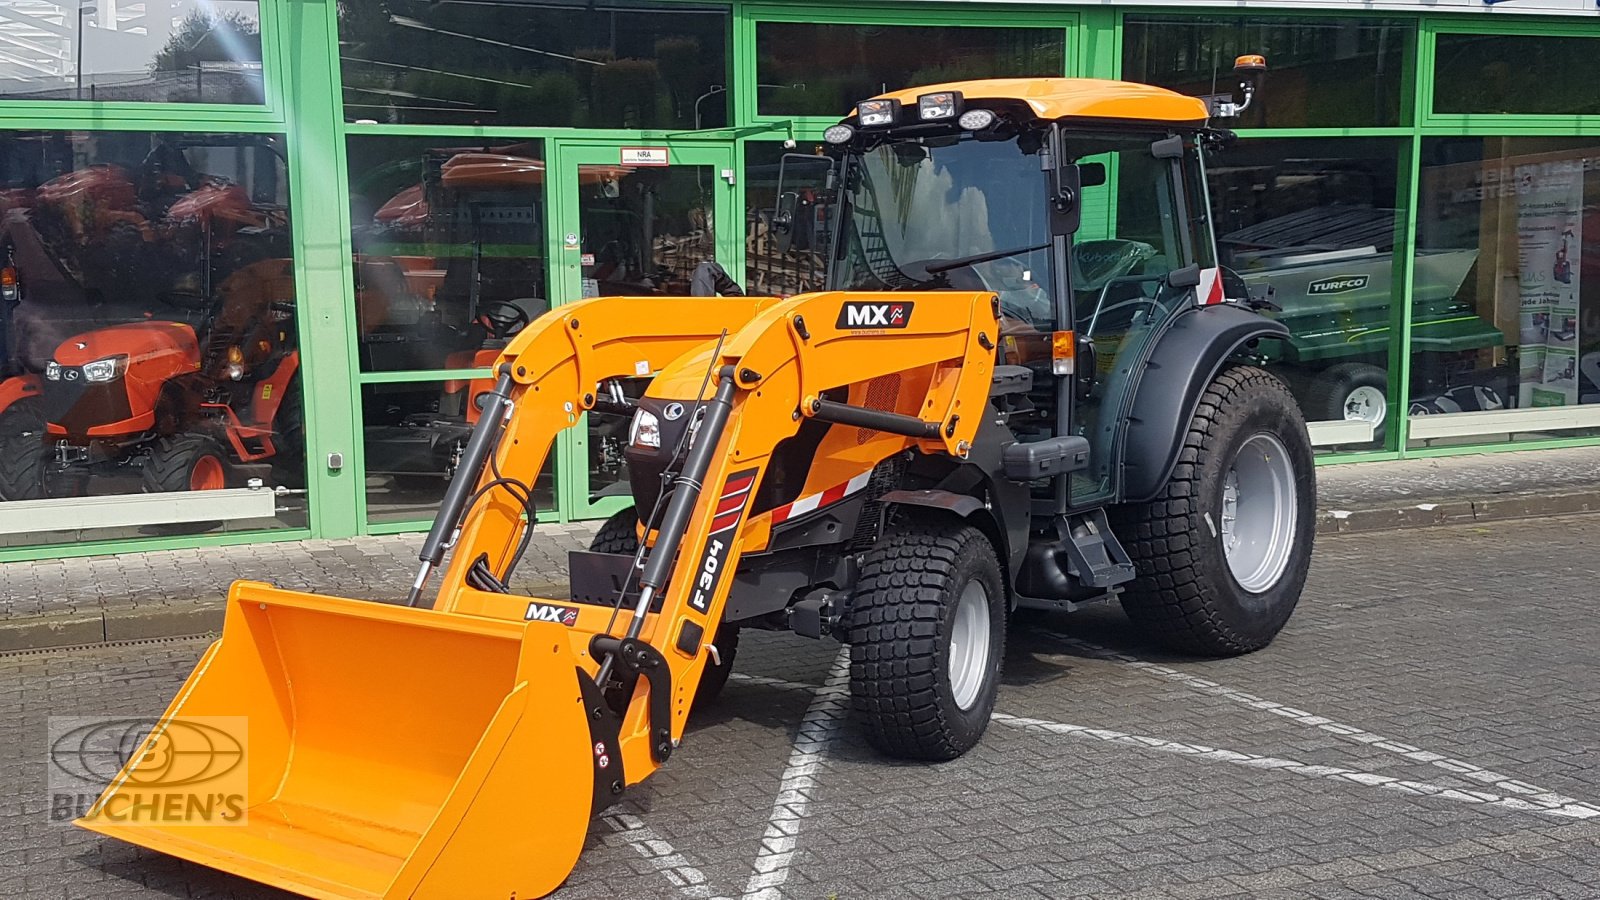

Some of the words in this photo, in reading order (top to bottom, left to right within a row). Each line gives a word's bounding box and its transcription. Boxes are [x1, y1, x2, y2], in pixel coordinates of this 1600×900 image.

[1313, 279, 1365, 291] TURFCO
[847, 305, 889, 325] MX
[693, 589, 705, 609] F
[699, 539, 724, 591] 304
[526, 603, 566, 622] MX
